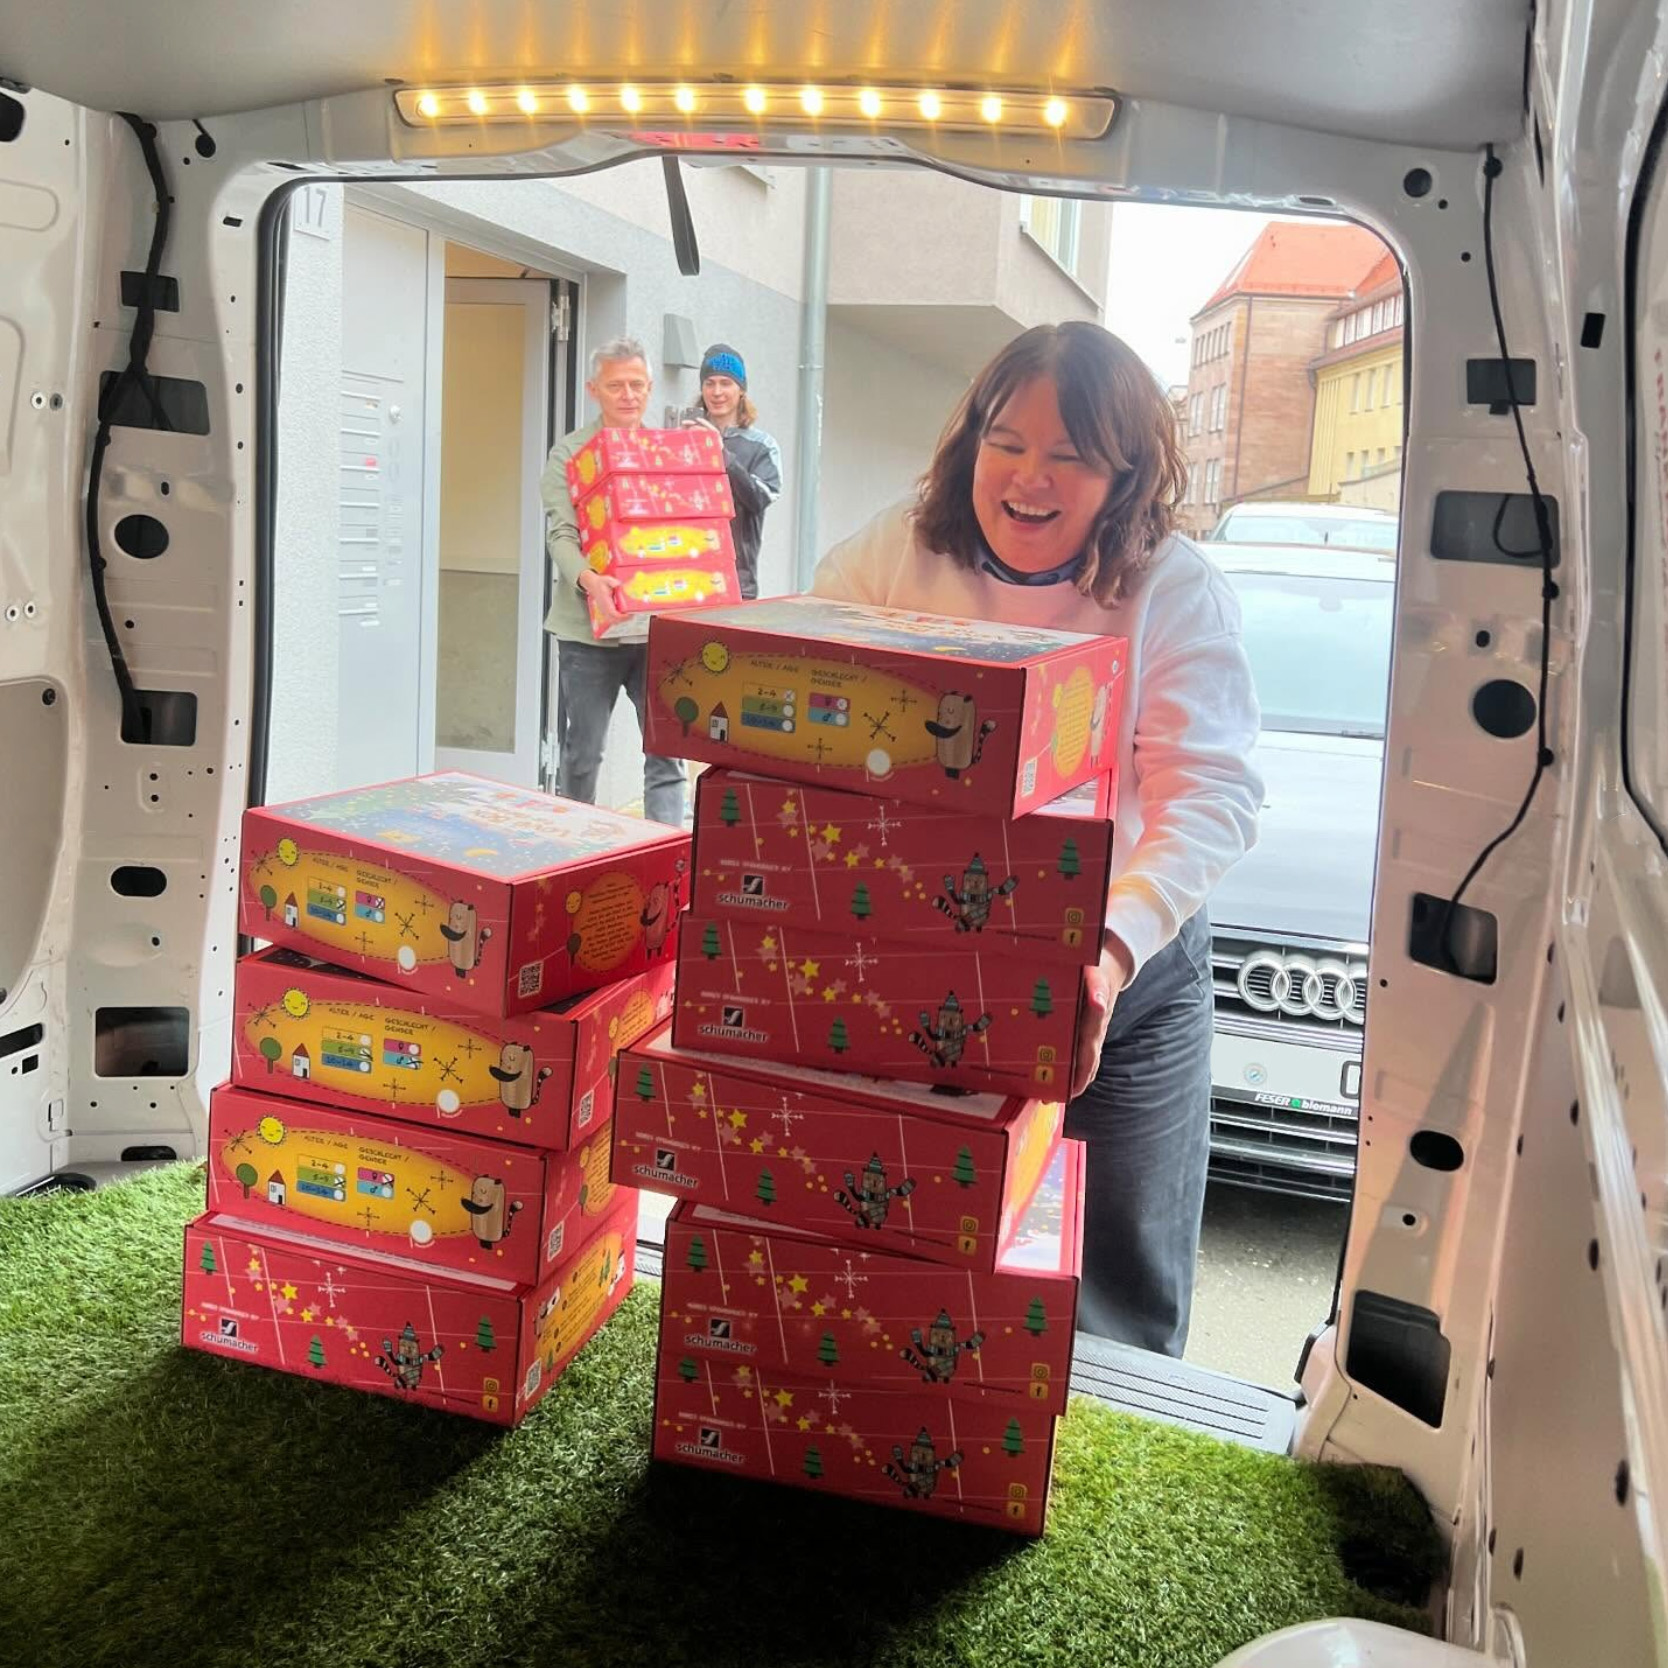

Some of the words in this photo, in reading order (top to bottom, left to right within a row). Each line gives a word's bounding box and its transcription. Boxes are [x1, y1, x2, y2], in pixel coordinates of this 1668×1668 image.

[303, 185, 327, 228] 17
[718, 892, 789, 910] schumacher
[699, 1023, 768, 1043] schumacher
[1254, 1093, 1291, 1107] FESER
[633, 1164, 699, 1187] schumacher
[201, 1330, 259, 1352] schumacher
[685, 1334, 758, 1353] schumacher
[676, 1442, 744, 1463] schumacher
